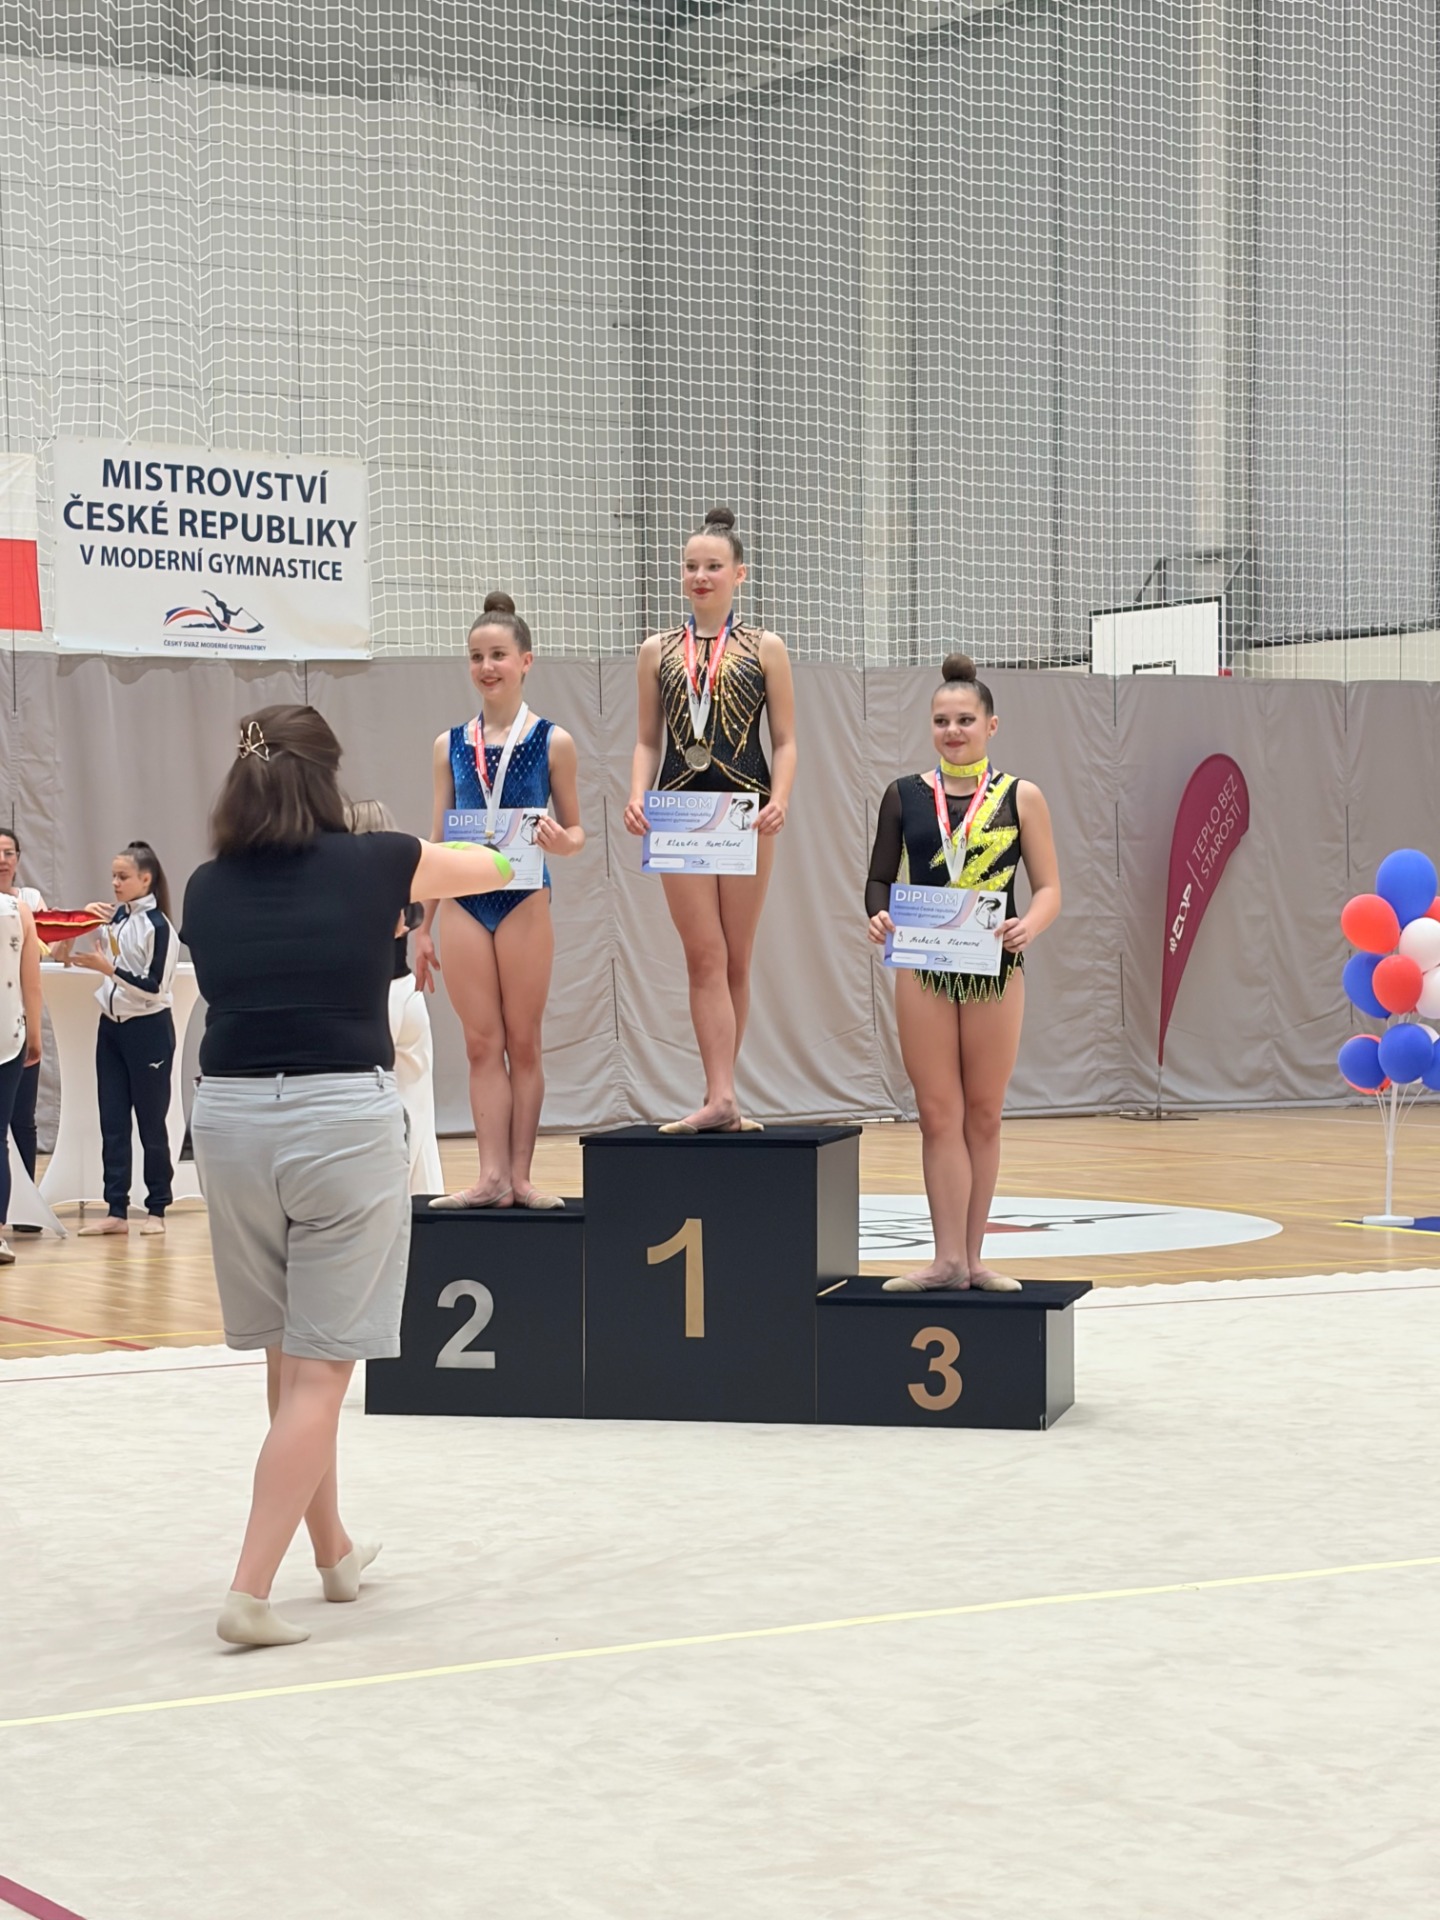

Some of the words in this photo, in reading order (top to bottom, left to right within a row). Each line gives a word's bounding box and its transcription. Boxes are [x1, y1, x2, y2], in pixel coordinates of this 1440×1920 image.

[102, 458, 330, 505] MISTROVSTVÍ
[63, 493, 169, 536] ČESKÉ
[179, 508, 358, 549] REPUBLIKY
[80, 544, 95, 565] V
[101, 545, 203, 572] MODERNÍ
[209, 552, 343, 582] GYMNASTICE
[163, 639, 182, 647] ČESKÝ
[649, 796, 712, 808] DIPLOM
[1191, 806, 1220, 863] TEPLO
[1217, 774, 1239, 808] BEZ
[1201, 797, 1242, 879] STAROSTÍ
[895, 889, 958, 906] DIPLOM
[646, 1217, 706, 1339] 1
[434, 1278, 497, 1370] 2
[906, 1325, 964, 1411] 3
